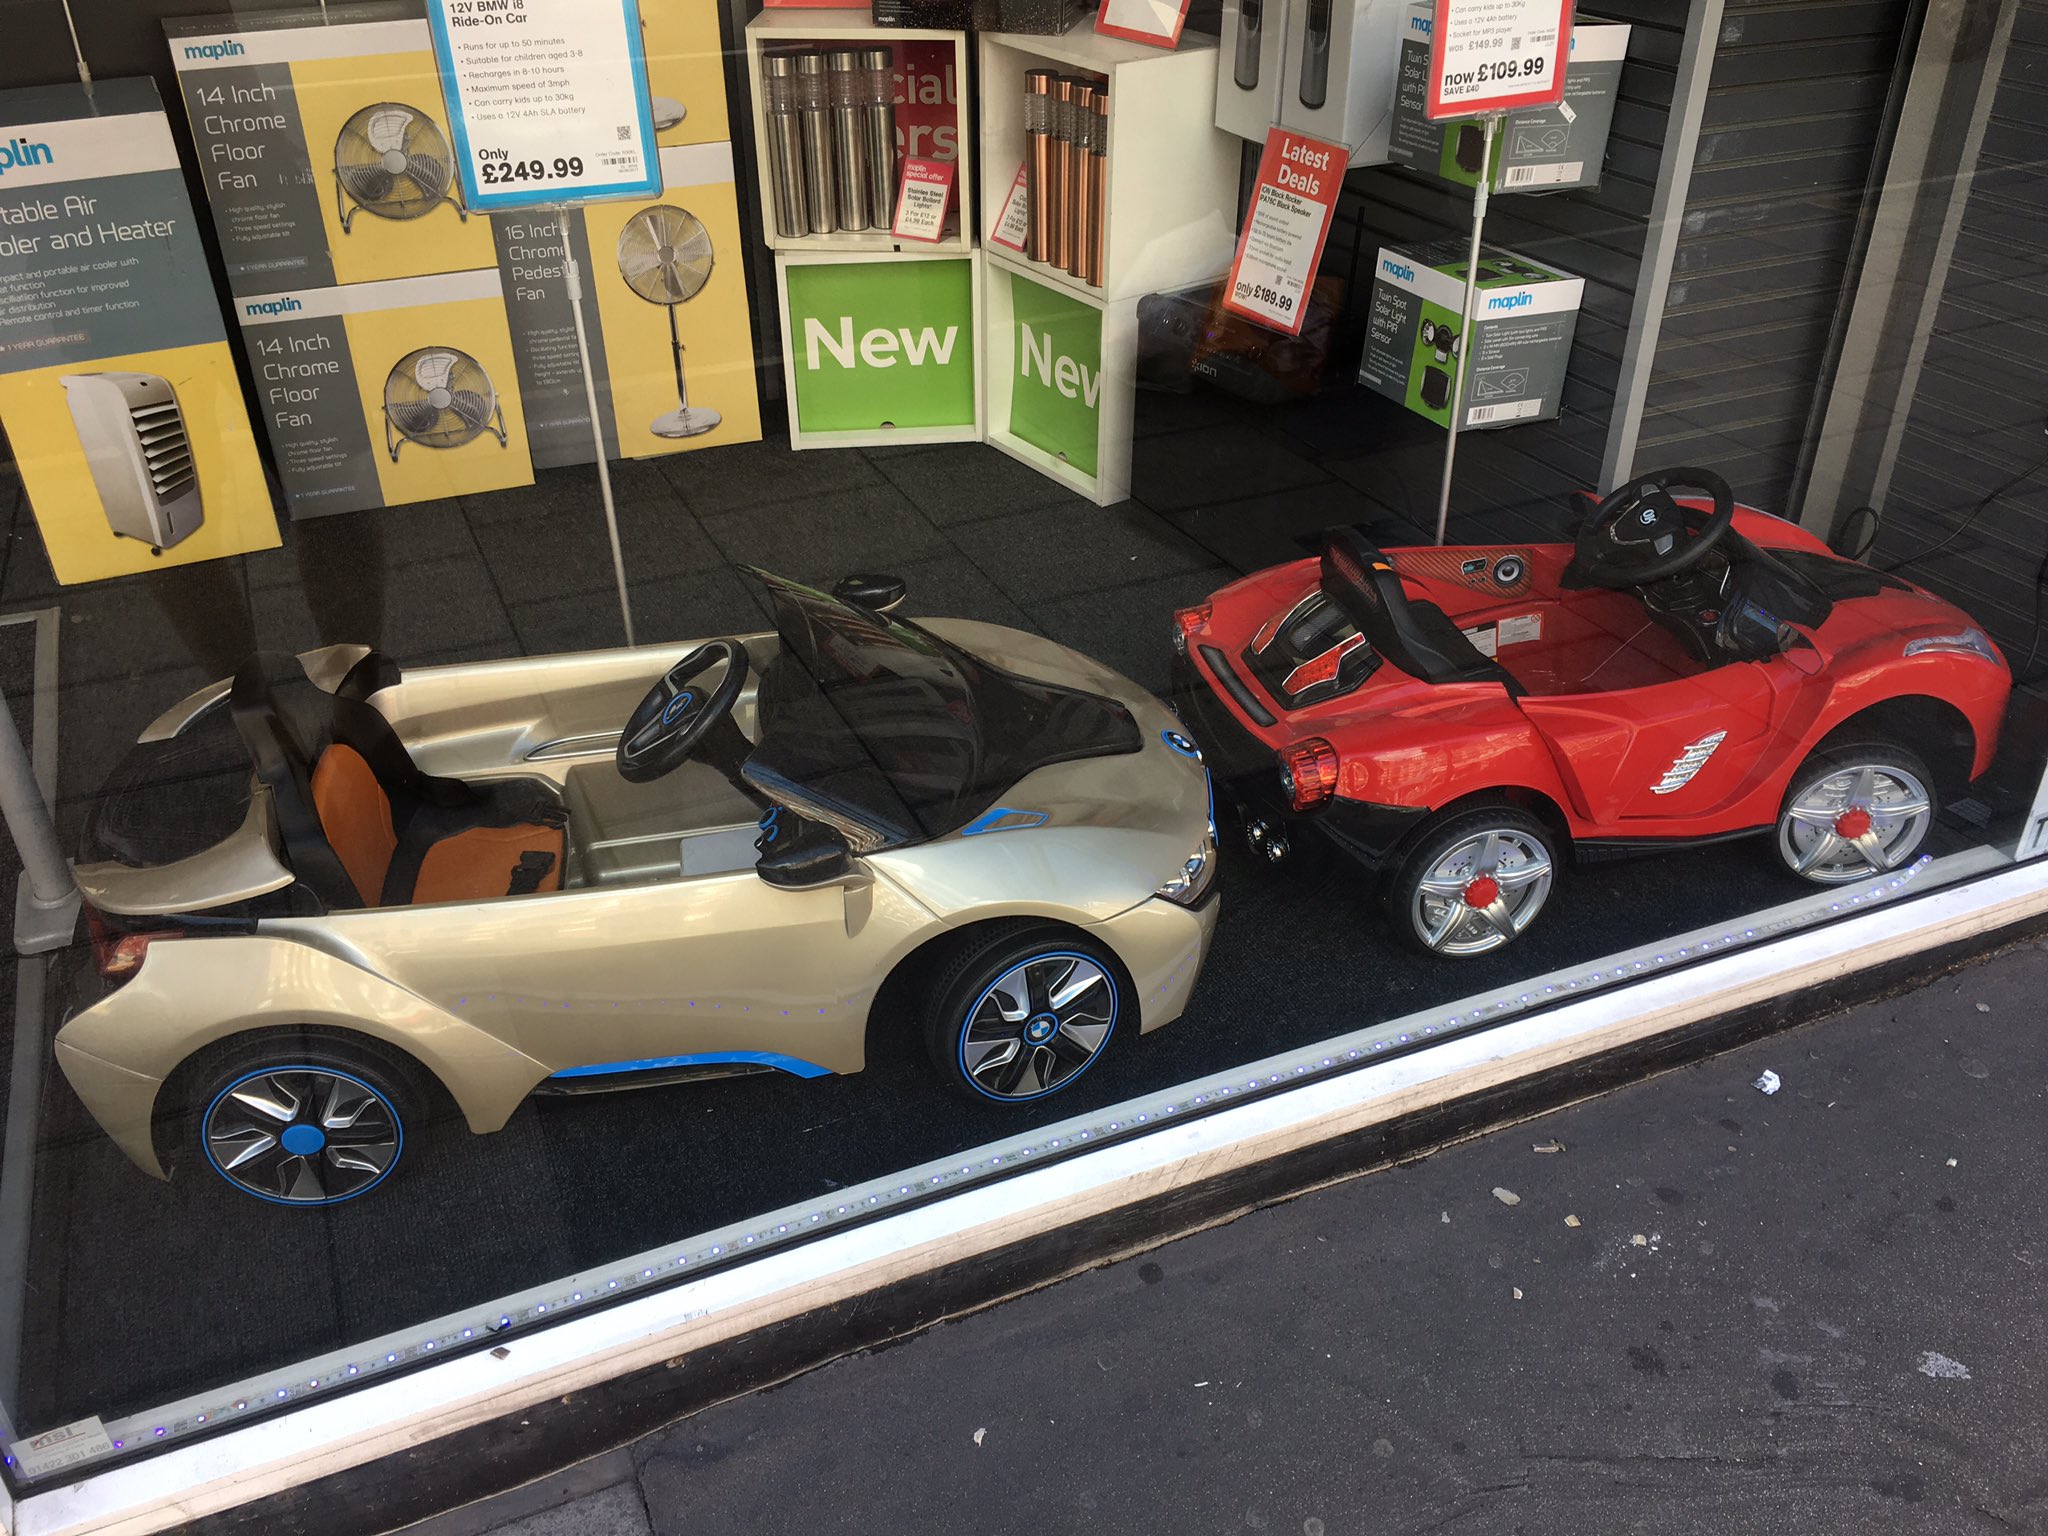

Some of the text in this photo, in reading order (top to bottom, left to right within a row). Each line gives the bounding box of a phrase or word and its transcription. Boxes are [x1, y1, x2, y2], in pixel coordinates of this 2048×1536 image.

[449, 2, 473, 14] 12V
[477, 0, 509, 12] BMW
[451, 13, 527, 28] Ride-On Car
[1453, 30, 1471, 38] Socket
[184, 40, 245, 61] maplin
[463, 37, 565, 51] Runs for up to 50 minutes
[1448, 38, 1503, 52] was £149.99
[465, 49, 584, 65] Suitable for children aged 3-8
[1407, 50, 1422, 64] Twin
[468, 65, 565, 80] Recharges in 8-10 hours
[1404, 65, 1421, 79] Solar
[1445, 71, 1475, 86] now
[1477, 57, 1545, 82] £109.99
[197, 83, 276, 106] 14 Inch
[471, 79, 570, 94] Maximum speed of 3mph
[1402, 82, 1417, 94] with
[1444, 84, 1479, 96] SAVE £40
[474, 93, 574, 107] Can carry kids up to 30kg
[1400, 95, 1423, 111] Sensor
[476, 112, 496, 121] Uses
[506, 110, 521, 119] 12V
[540, 107, 556, 116] SLA
[558, 105, 586, 116] battery
[204, 115, 287, 135] Chrome
[211, 144, 266, 163] Floor
[478, 149, 509, 161] Only
[1282, 138, 1330, 171] Latest
[481, 156, 584, 184] £249.99
[218, 171, 258, 190] Fan
[1277, 164, 1320, 196] Deals
[64, 196, 97, 218] Air
[50, 225, 93, 250] and
[97, 219, 176, 244] Heater
[505, 225, 525, 240] 16
[26, 257, 139, 280] and portable air cooler with
[1383, 259, 1414, 282] maplin
[9, 280, 46, 292] function
[40, 279, 130, 299] function for improved
[516, 287, 545, 301] Fan
[1236, 281, 1254, 297] only
[1253, 284, 1293, 311] £189.99
[1378, 288, 1407, 310] Twin Spot
[1488, 292, 1533, 311] maplin
[8, 301, 56, 315] distribution
[33, 310, 63, 322] control
[65, 306, 81, 317] and
[82, 304, 103, 314] timer
[105, 299, 139, 311] function
[246, 298, 302, 315] maplin
[1375, 302, 1407, 324] Solar Light
[1373, 316, 1398, 334] with PIR
[804, 316, 959, 370] New
[1371, 327, 1391, 344] Sensor
[257, 333, 331, 356] 14 Inch
[264, 361, 339, 380] Chrome
[269, 388, 320, 405] Floor
[275, 411, 312, 428] Fan
